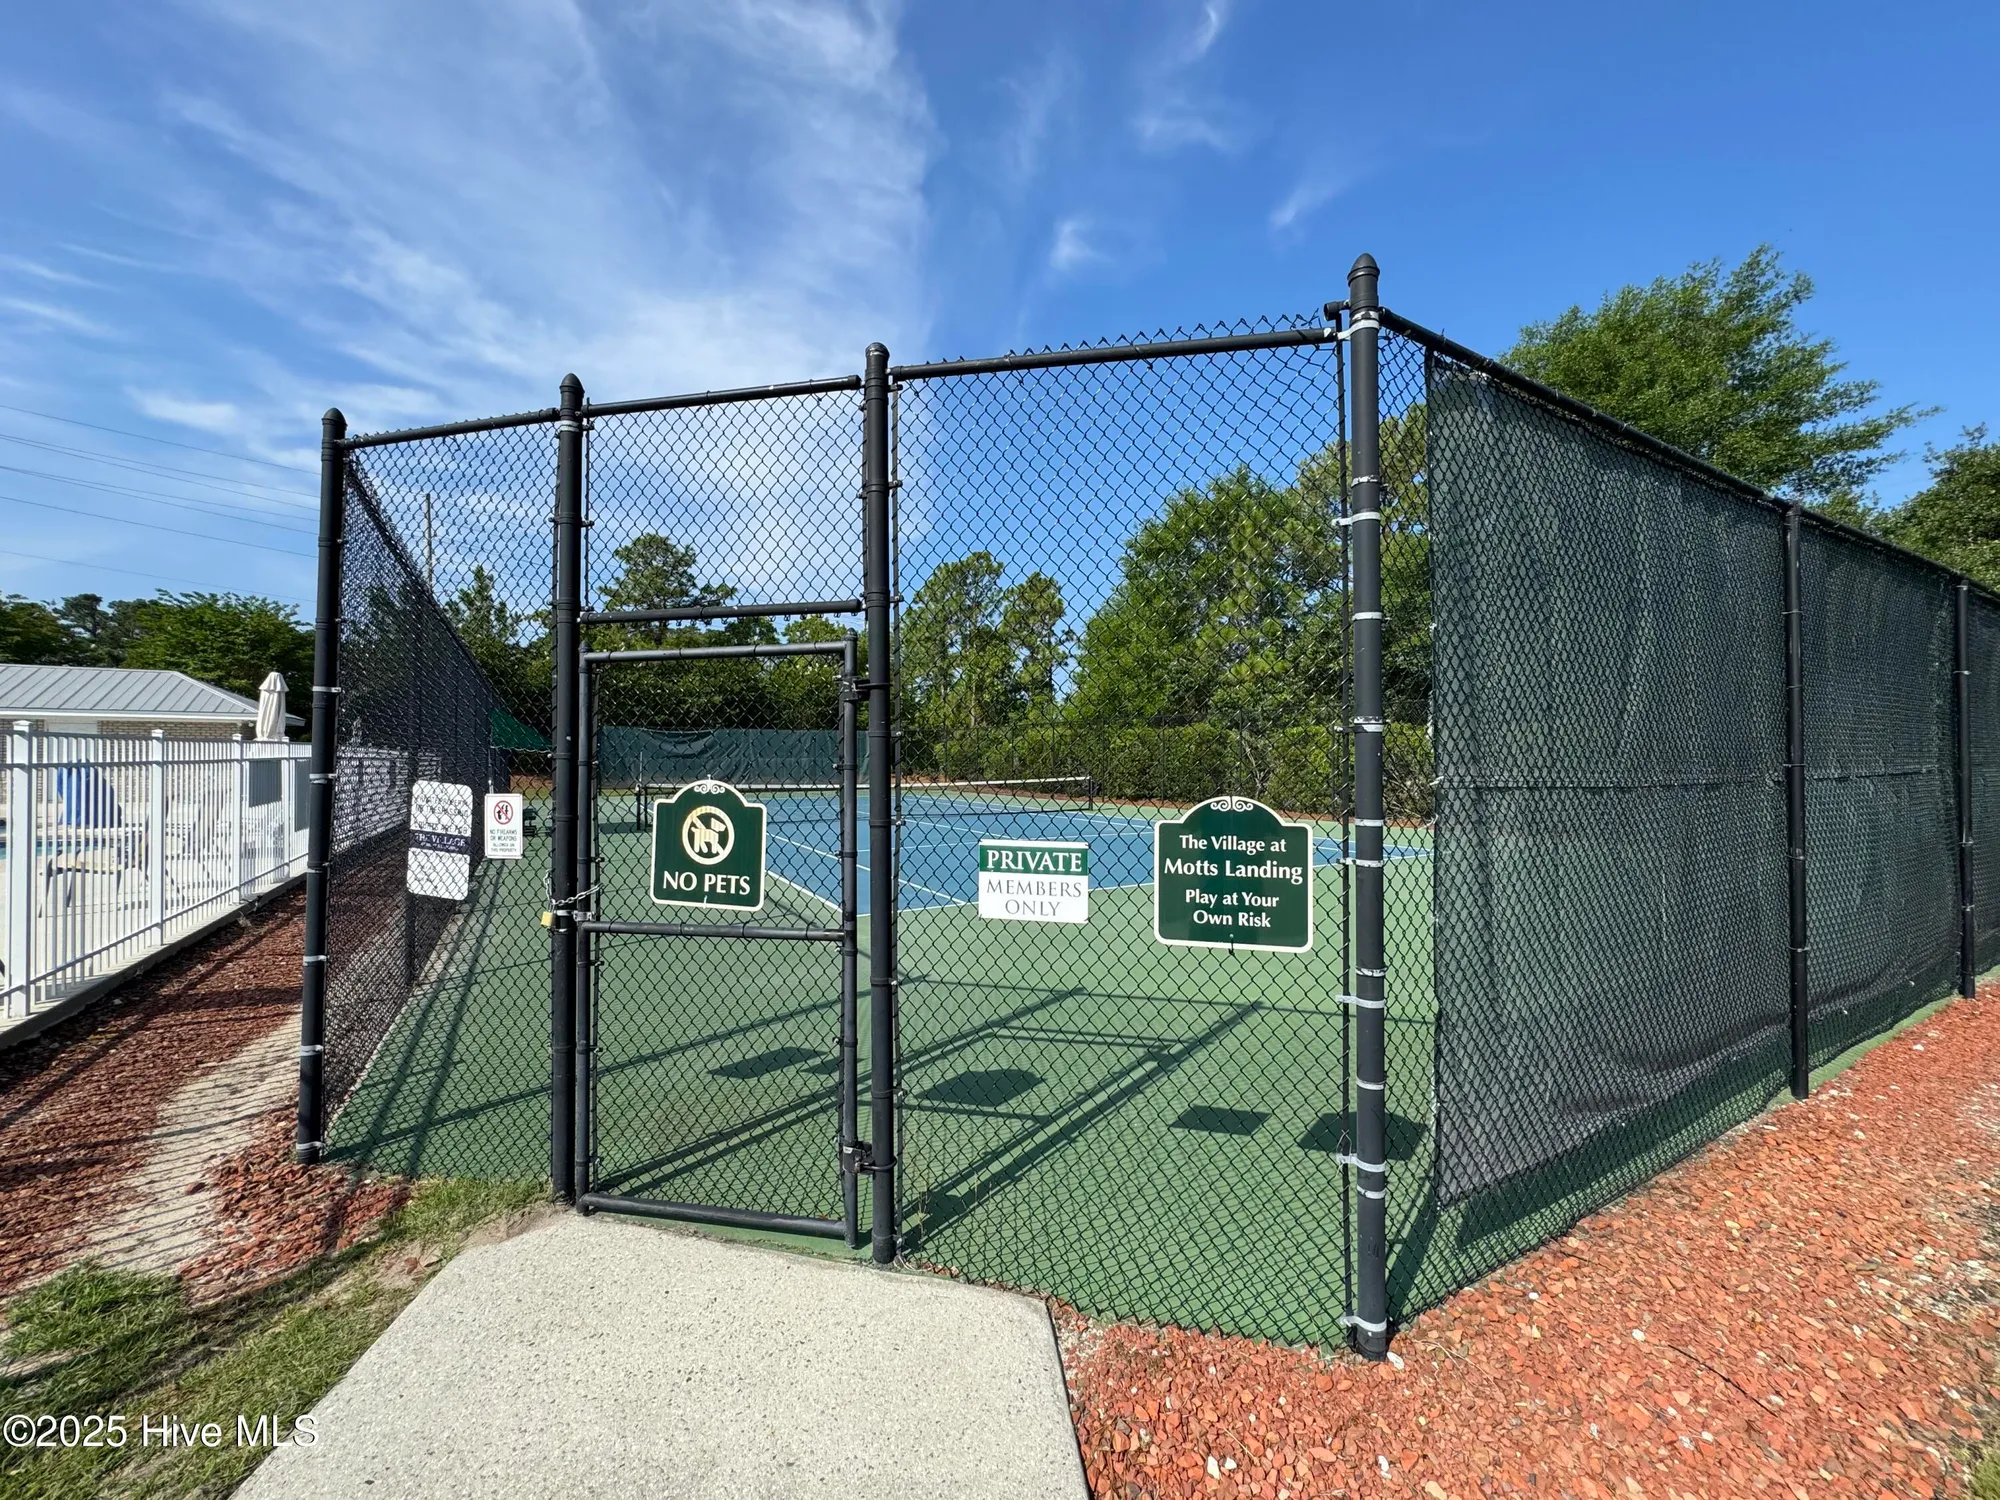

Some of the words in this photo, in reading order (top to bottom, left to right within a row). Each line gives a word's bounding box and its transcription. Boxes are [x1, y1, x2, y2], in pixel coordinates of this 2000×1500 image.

[1179, 834, 1207, 850] The
[1211, 835, 1265, 855] Village
[1270, 838, 1287, 852] at
[986, 849, 1082, 872] PRIVATE
[1164, 857, 1218, 876] Motts
[1225, 860, 1303, 885] Landing
[663, 870, 698, 891] NO
[703, 873, 751, 896] PETS
[986, 879, 1082, 898] MEMBERS
[1005, 899, 1061, 916] ONLY
[1185, 889, 1218, 908] Play
[1222, 892, 1239, 906] at
[1242, 891, 1280, 908] Your
[1193, 909, 1232, 925] Own
[1238, 912, 1271, 928] Risk
